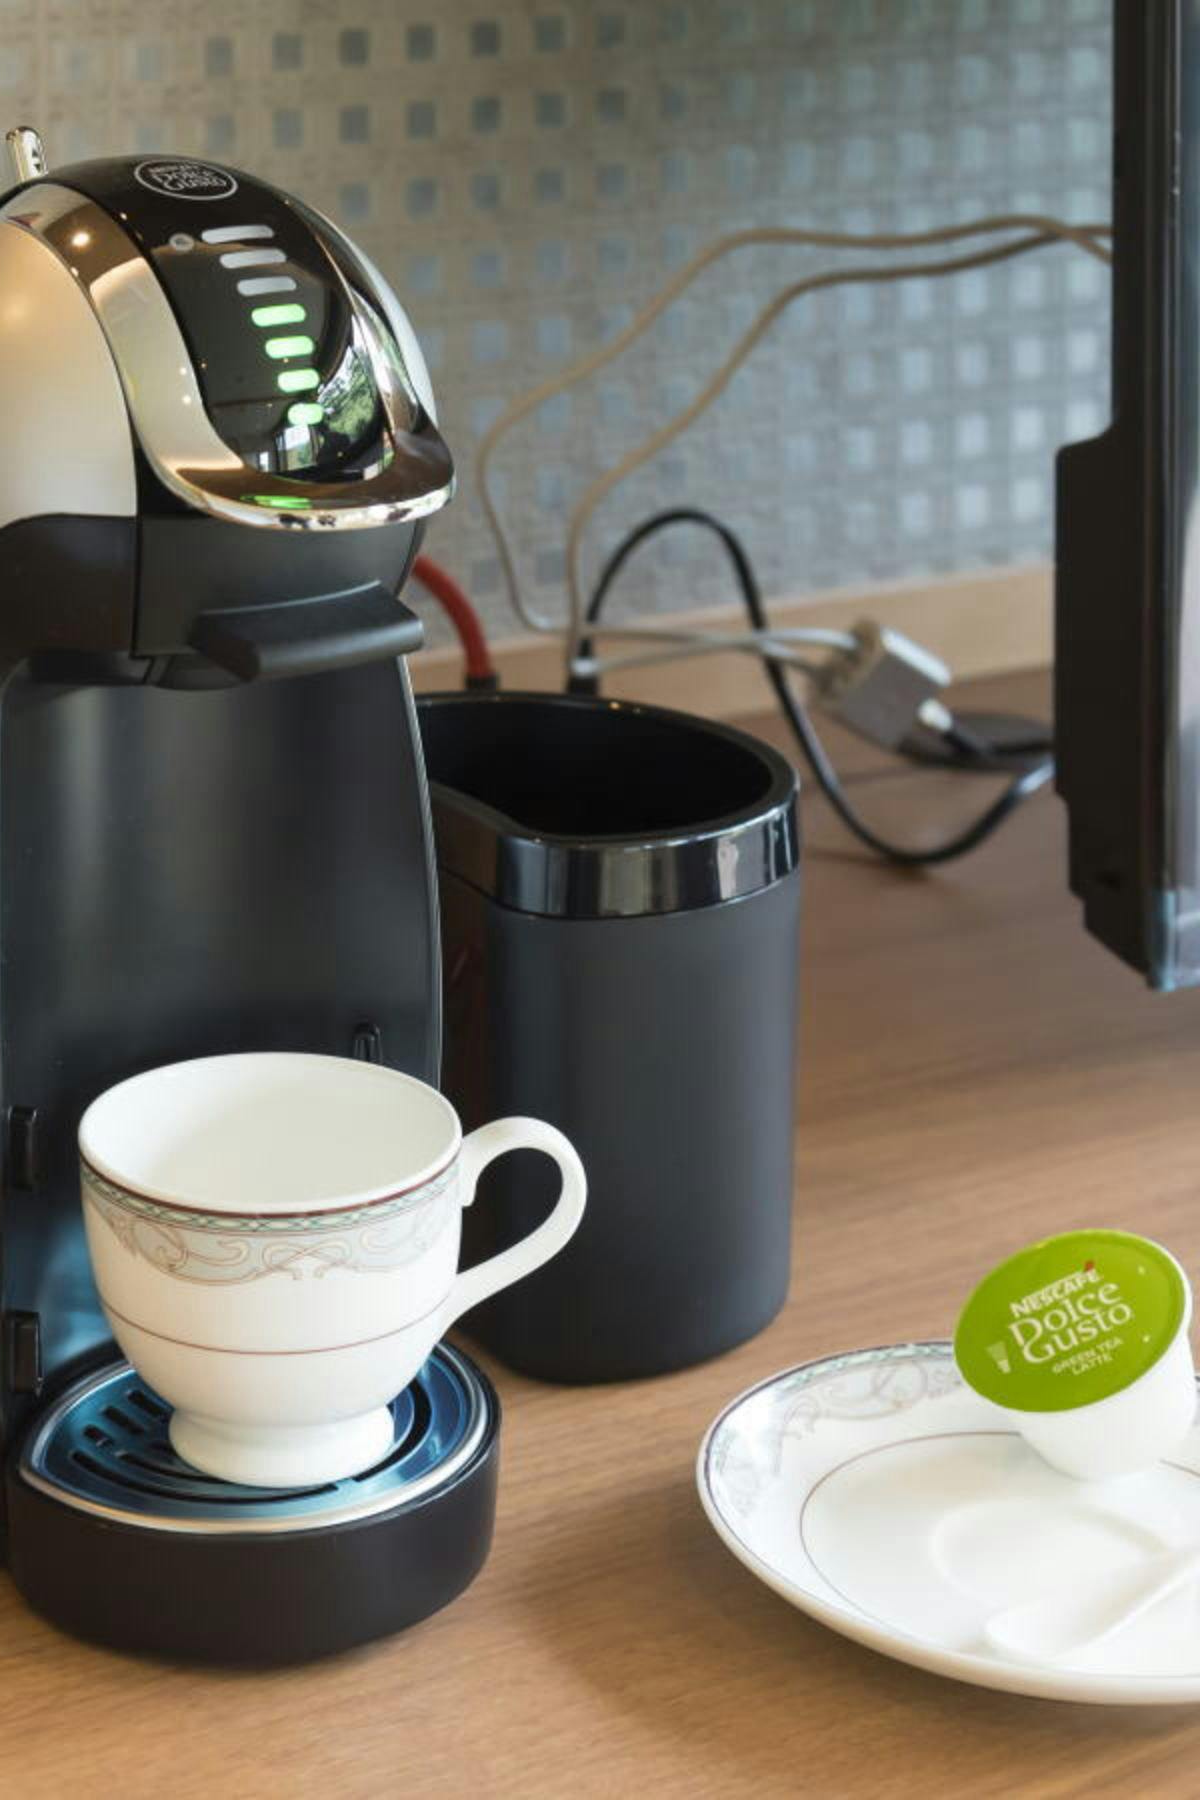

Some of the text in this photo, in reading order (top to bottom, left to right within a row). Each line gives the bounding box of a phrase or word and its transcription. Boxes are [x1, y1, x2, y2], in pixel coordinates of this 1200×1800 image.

[1008, 1283, 1122, 1346] Dolce
[1023, 1303, 1133, 1364] Gusto
[1095, 1336, 1124, 1352] TEA
